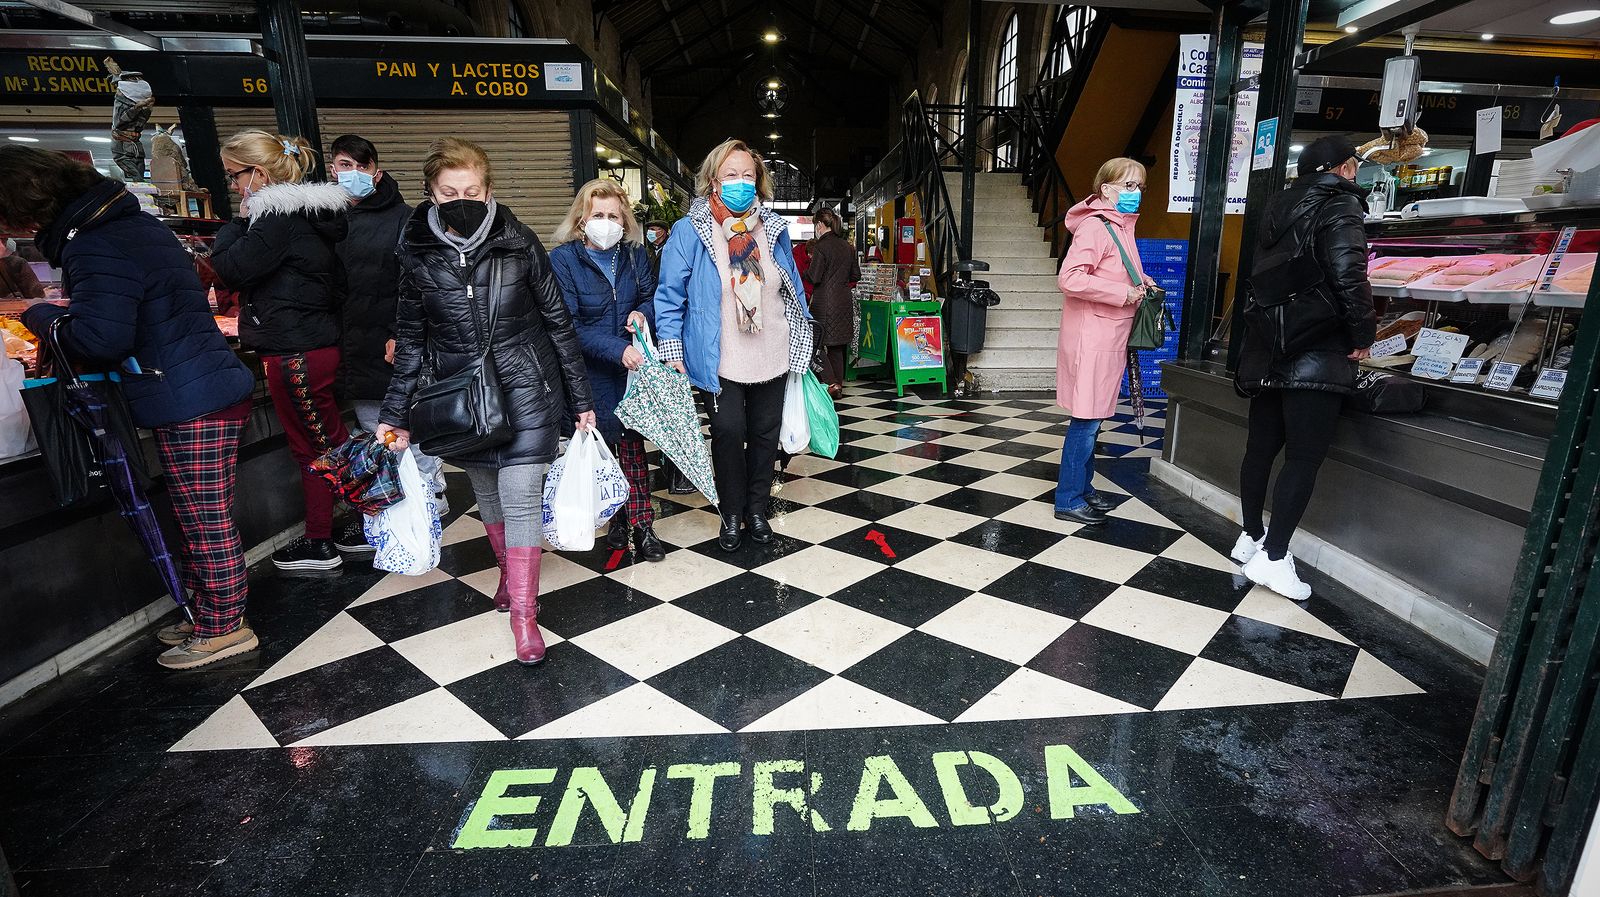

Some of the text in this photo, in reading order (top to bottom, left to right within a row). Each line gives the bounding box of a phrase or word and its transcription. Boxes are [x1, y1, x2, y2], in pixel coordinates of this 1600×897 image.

[27, 55, 99, 72] RECOVA
[376, 61, 540, 79] PAN Y LACTEOS
[5, 76, 29, 92] Mª
[33, 76, 46, 92] J.
[242, 78, 268, 93] 56
[451, 81, 528, 96] A. COBO
[1325, 107, 1344, 120] 57
[1503, 105, 1520, 119] 58
[451, 744, 1142, 849] ENTRADA
